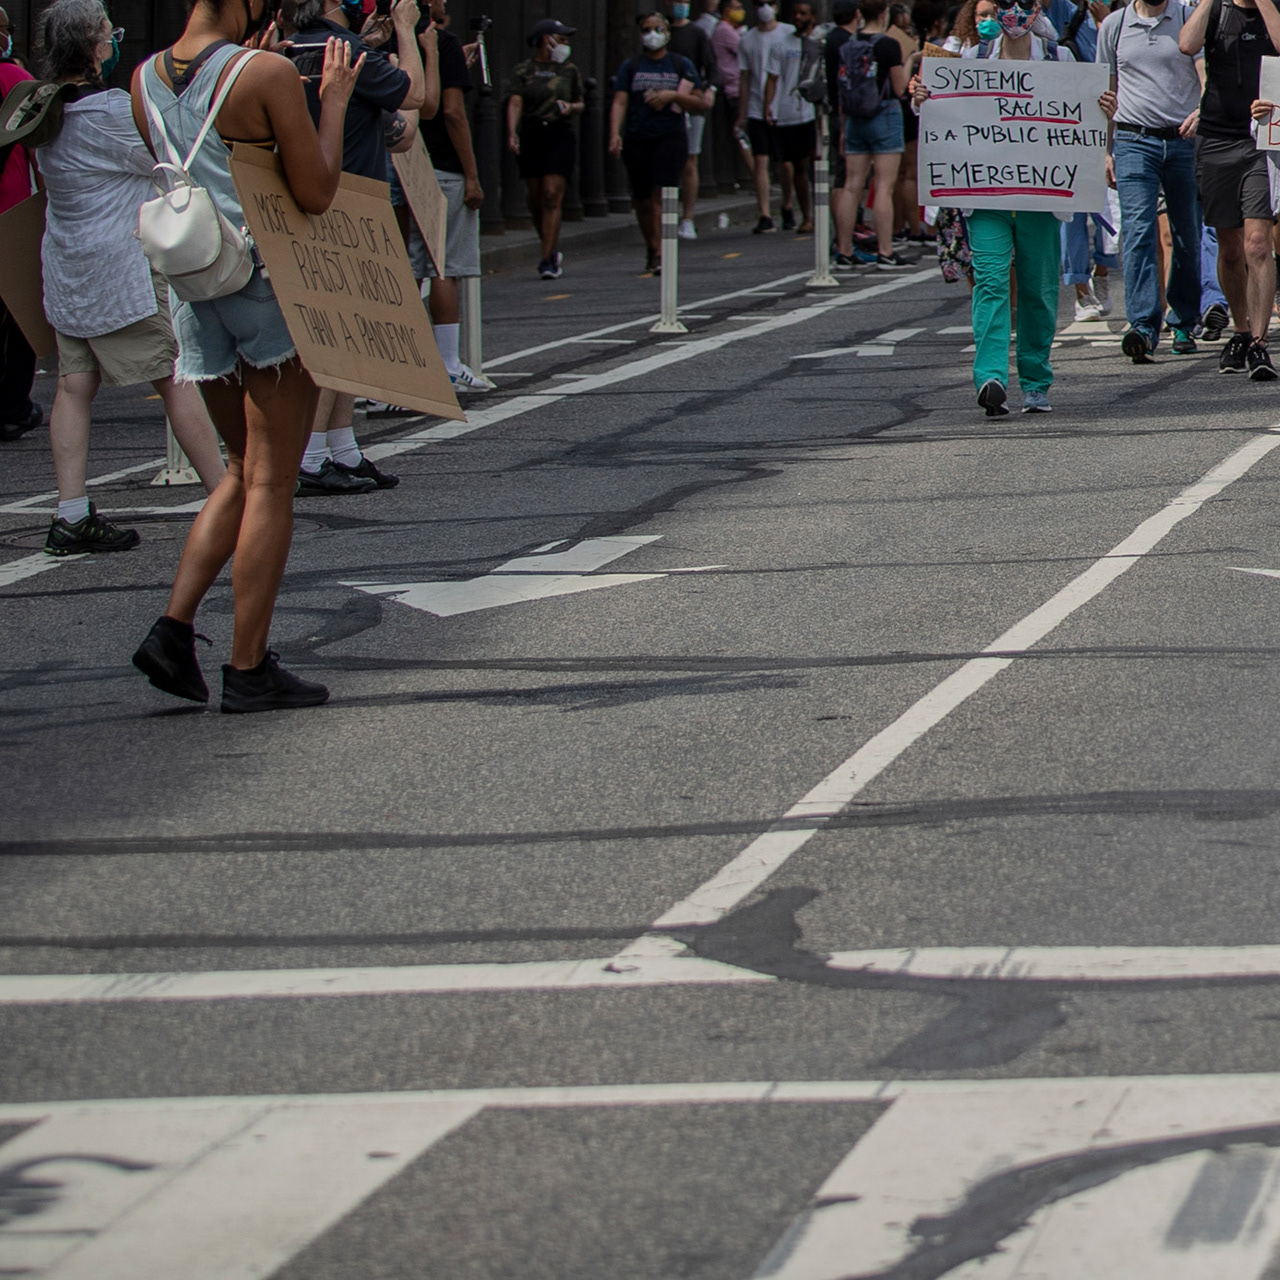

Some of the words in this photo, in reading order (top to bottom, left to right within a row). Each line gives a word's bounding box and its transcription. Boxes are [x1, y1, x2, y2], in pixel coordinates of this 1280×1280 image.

[932, 67, 1034, 94] SYSTEMIC
[995, 98, 1082, 122] RACISM
[925, 130, 938, 144] IS
[945, 130, 958, 141] A
[963, 125, 1039, 146] PUBLIC
[1047, 128, 1106, 147] HEALTH
[927, 162, 1078, 189] EMERGENCY
[253, 192, 294, 236] MORE
[360, 218, 378, 254] OF
[381, 222, 399, 260] A
[292, 241, 352, 297] RACIST
[350, 257, 403, 307] WORLD
[294, 303, 338, 348] THAN
[339, 311, 360, 355] A
[354, 313, 426, 368] PANDEMIC
